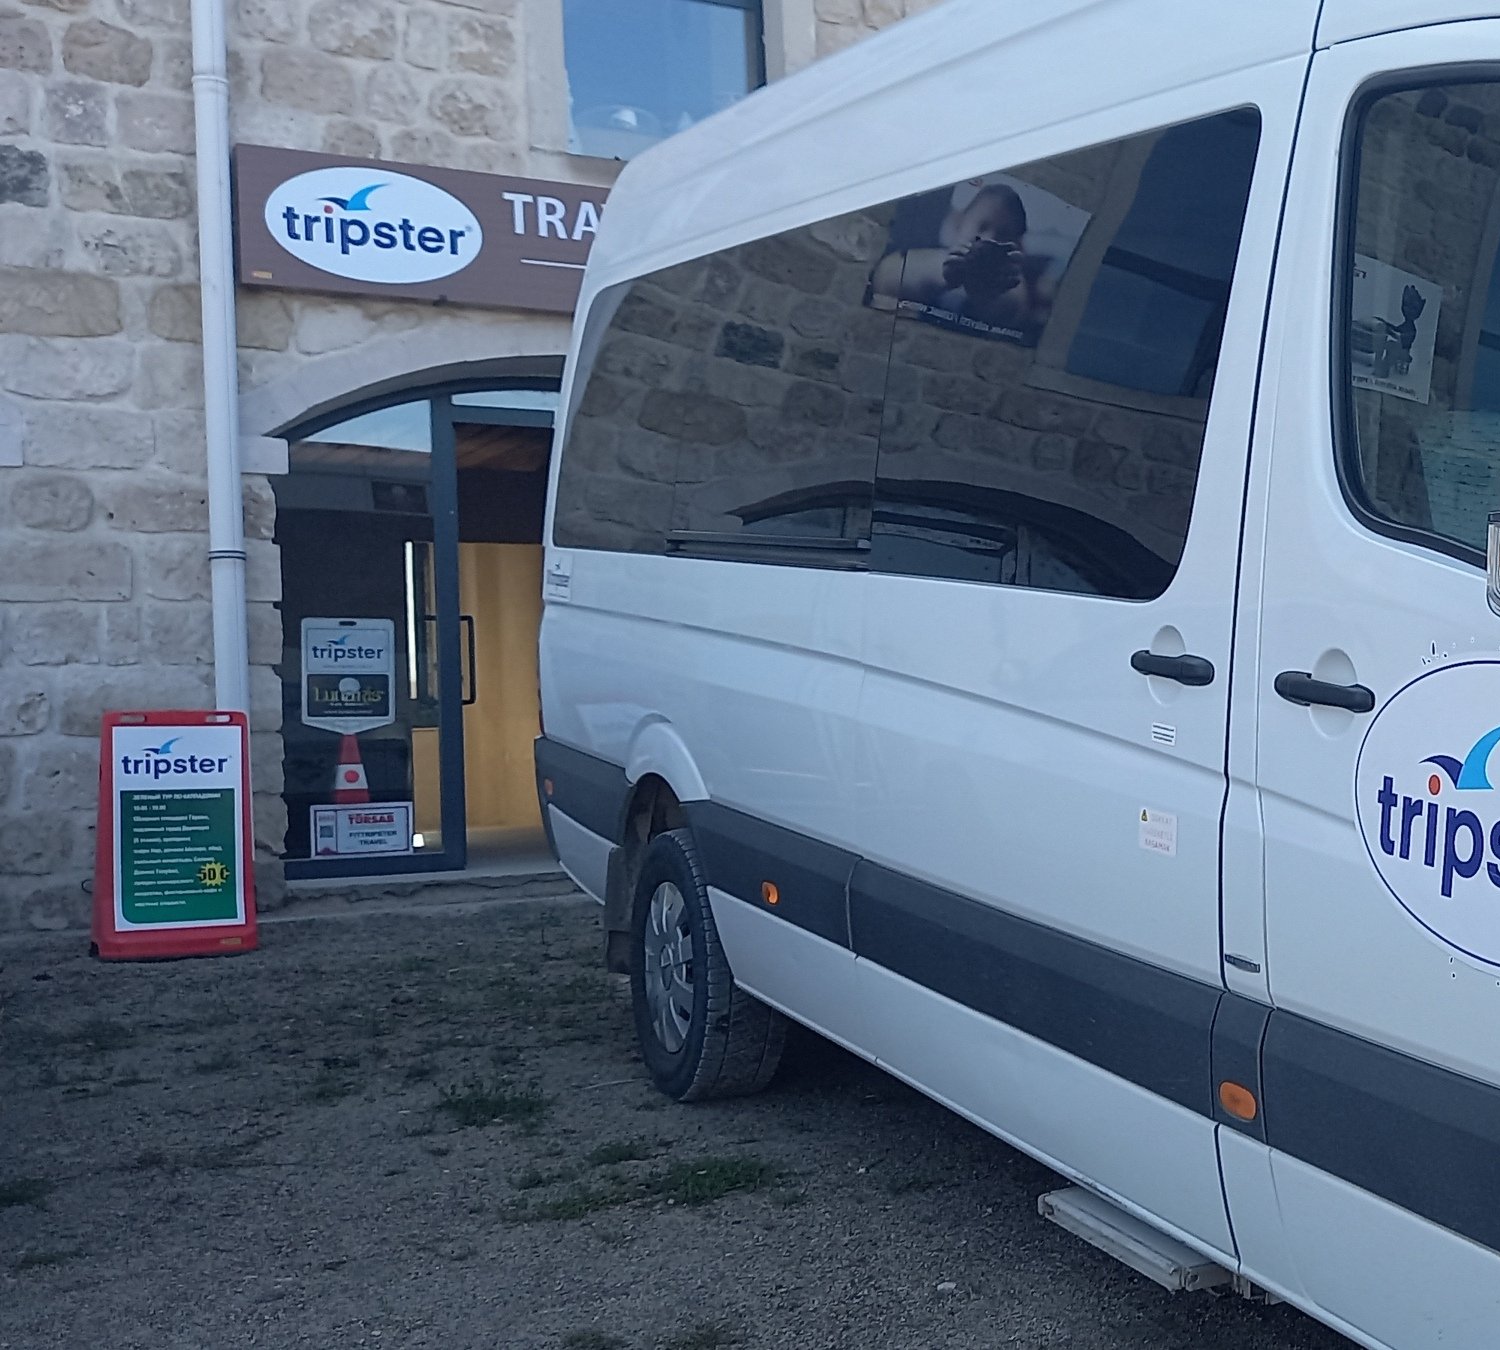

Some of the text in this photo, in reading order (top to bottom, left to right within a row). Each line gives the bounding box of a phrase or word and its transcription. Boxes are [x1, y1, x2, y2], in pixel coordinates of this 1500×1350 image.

[283, 205, 465, 255] tripster
[502, 191, 607, 241] TRA
[312, 644, 384, 662] tripster
[121, 754, 228, 780] tripster
